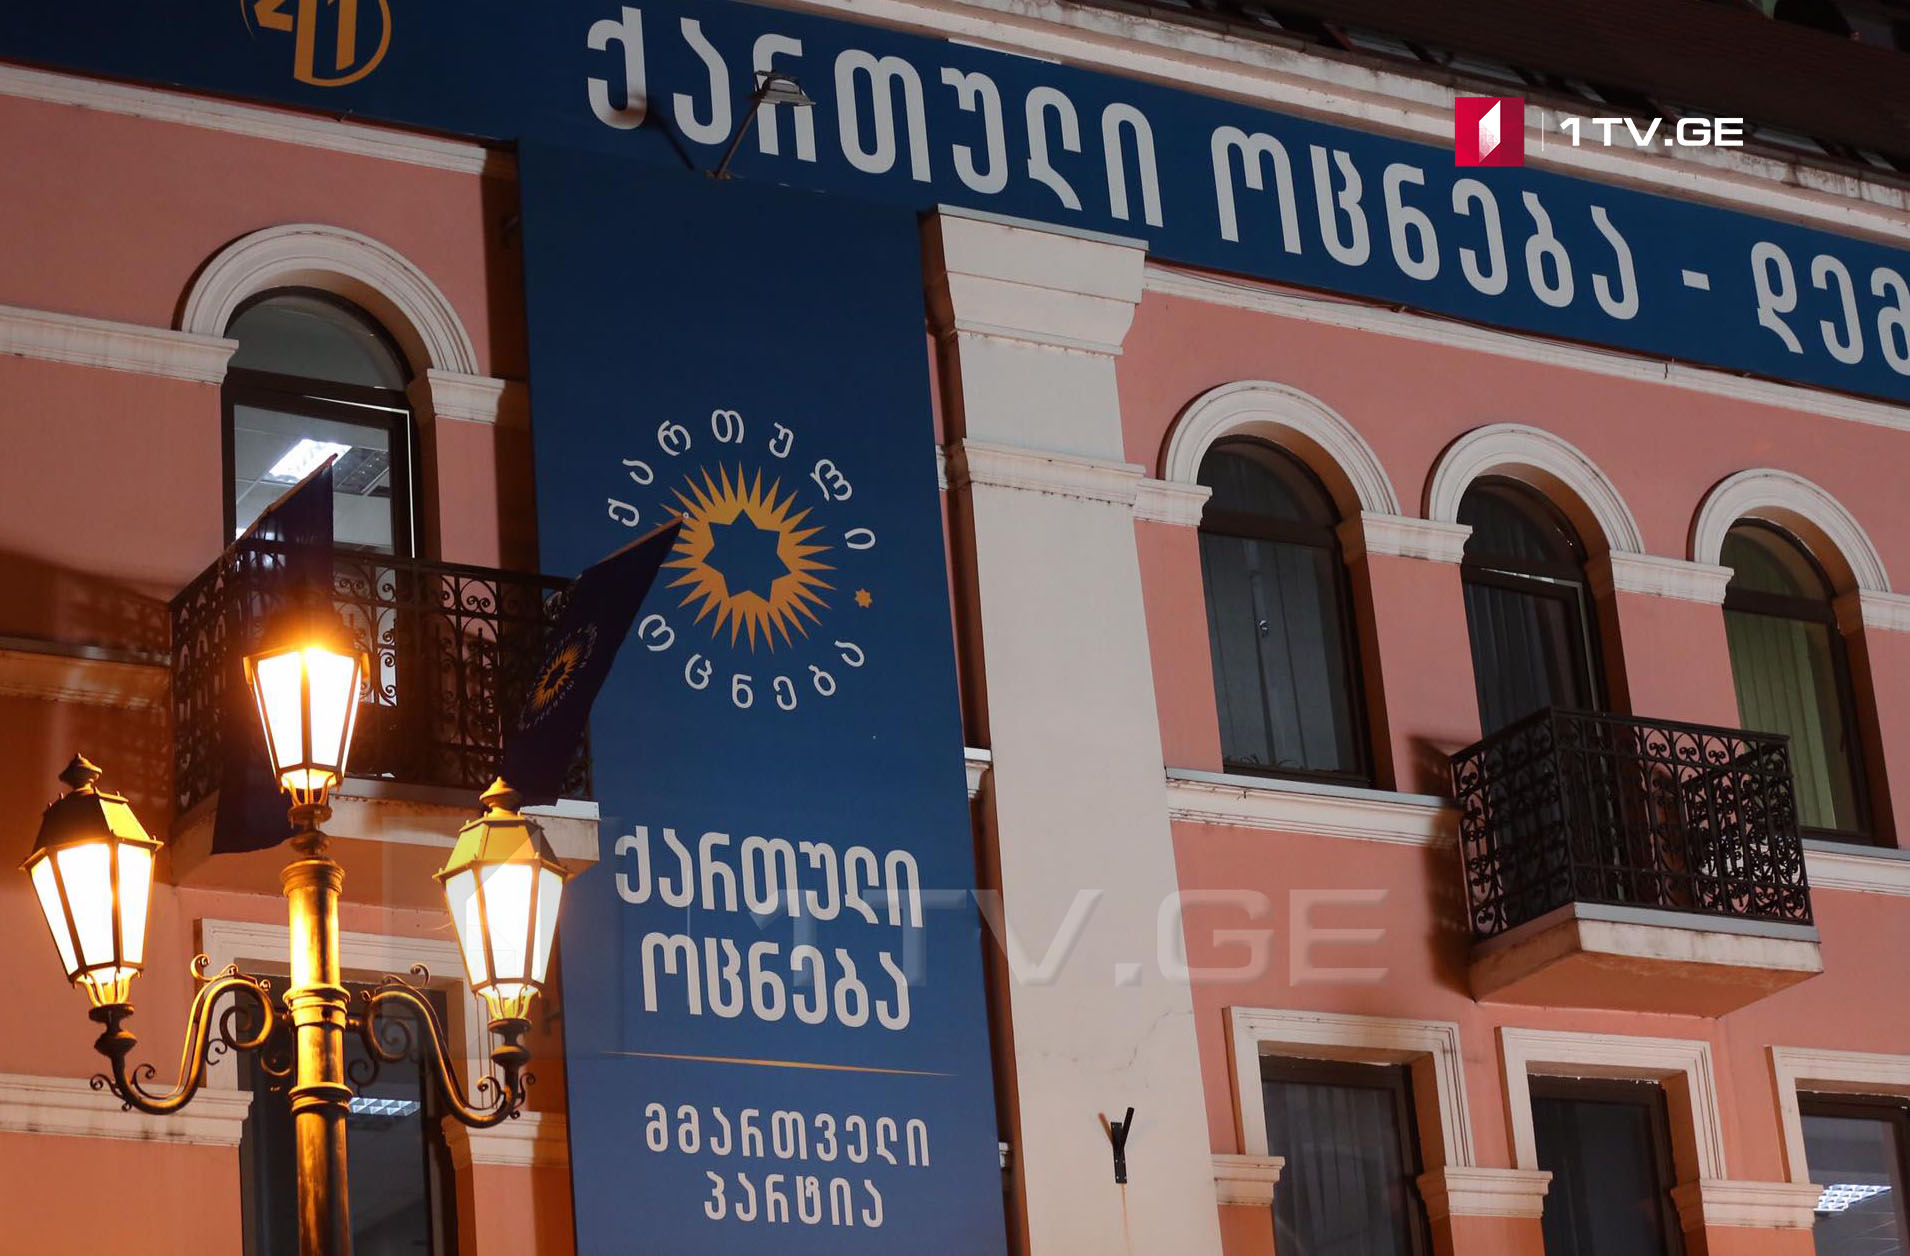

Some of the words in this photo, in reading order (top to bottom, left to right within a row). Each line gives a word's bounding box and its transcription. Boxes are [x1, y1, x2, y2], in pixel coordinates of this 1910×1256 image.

[587, 5, 1164, 228] ქართული
[1211, 125, 1640, 320] ოცნება
[614, 825, 924, 928] ქართული
[641, 931, 911, 1031] ოცნება
[644, 1102, 931, 1168] მმართველი
[704, 1171, 884, 1228] პარტია
